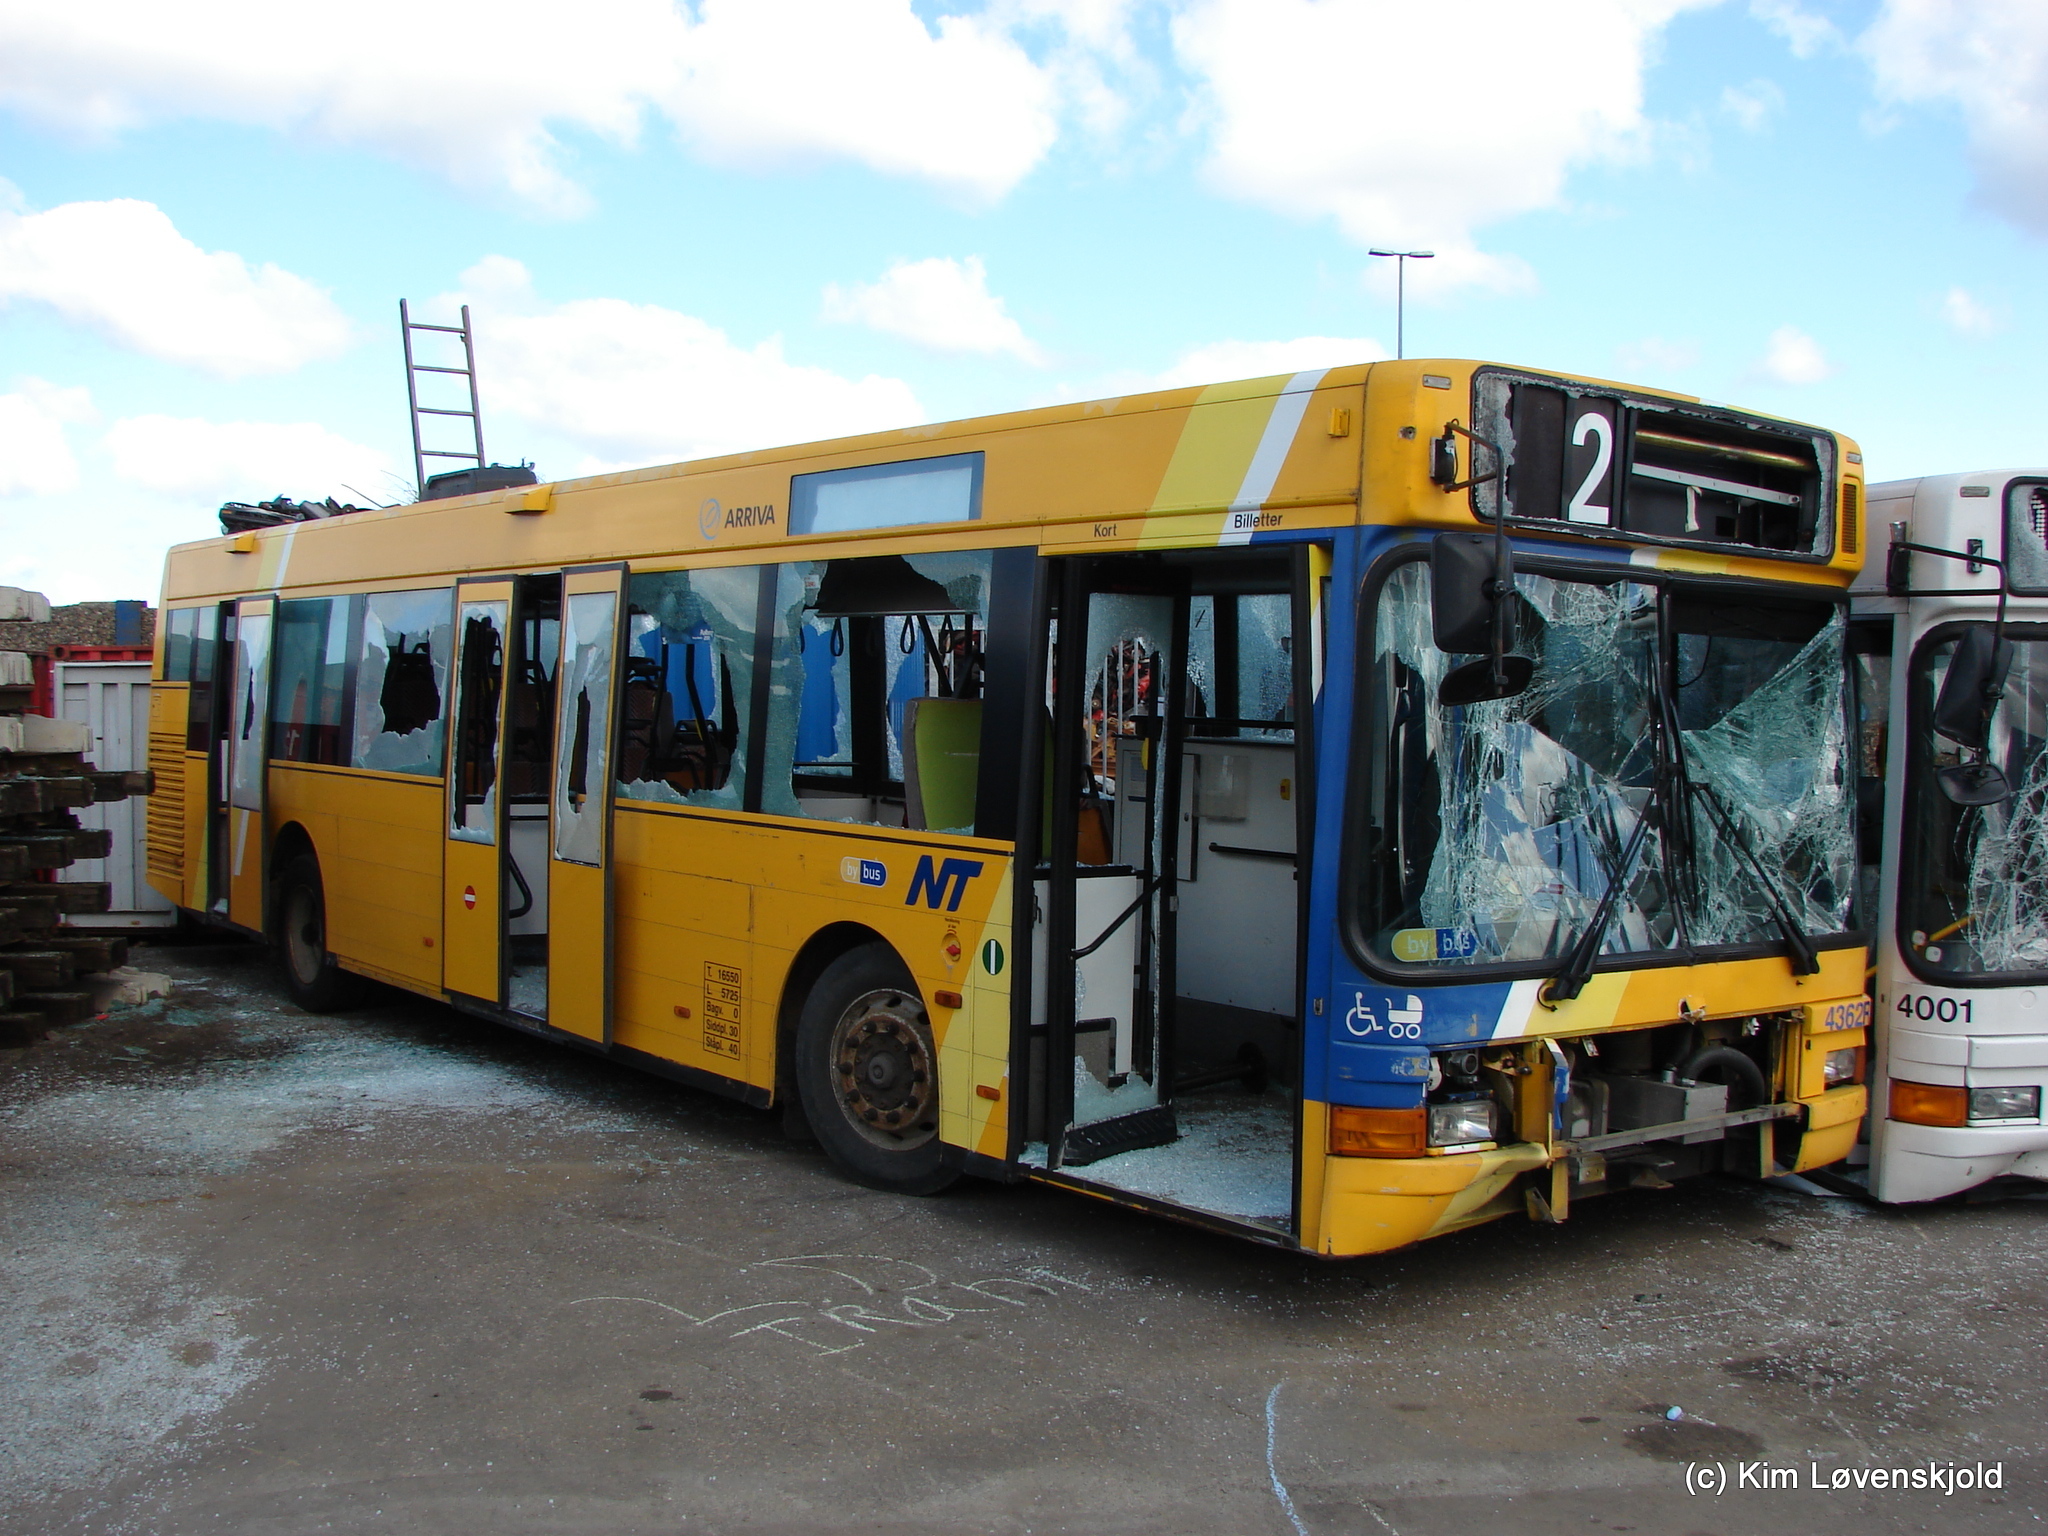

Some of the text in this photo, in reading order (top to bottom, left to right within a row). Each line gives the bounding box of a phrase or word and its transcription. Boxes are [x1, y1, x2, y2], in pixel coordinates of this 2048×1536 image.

[1568, 412, 1613, 525] 2
[724, 504, 775, 529] ARRIVA
[1234, 514, 1283, 529] Billetter
[1093, 523, 1118, 538] Kort
[863, 863, 881, 881] bus
[905, 854, 985, 912] NT
[1408, 936, 1430, 957] by
[718, 969, 739, 983] 16550
[721, 988, 739, 1001] 5725
[706, 1001, 738, 1019] Bagv. 0
[1896, 993, 1973, 1024] 4001
[728, 1025, 739, 1037] 30
[728, 1043, 738, 1055] 40
